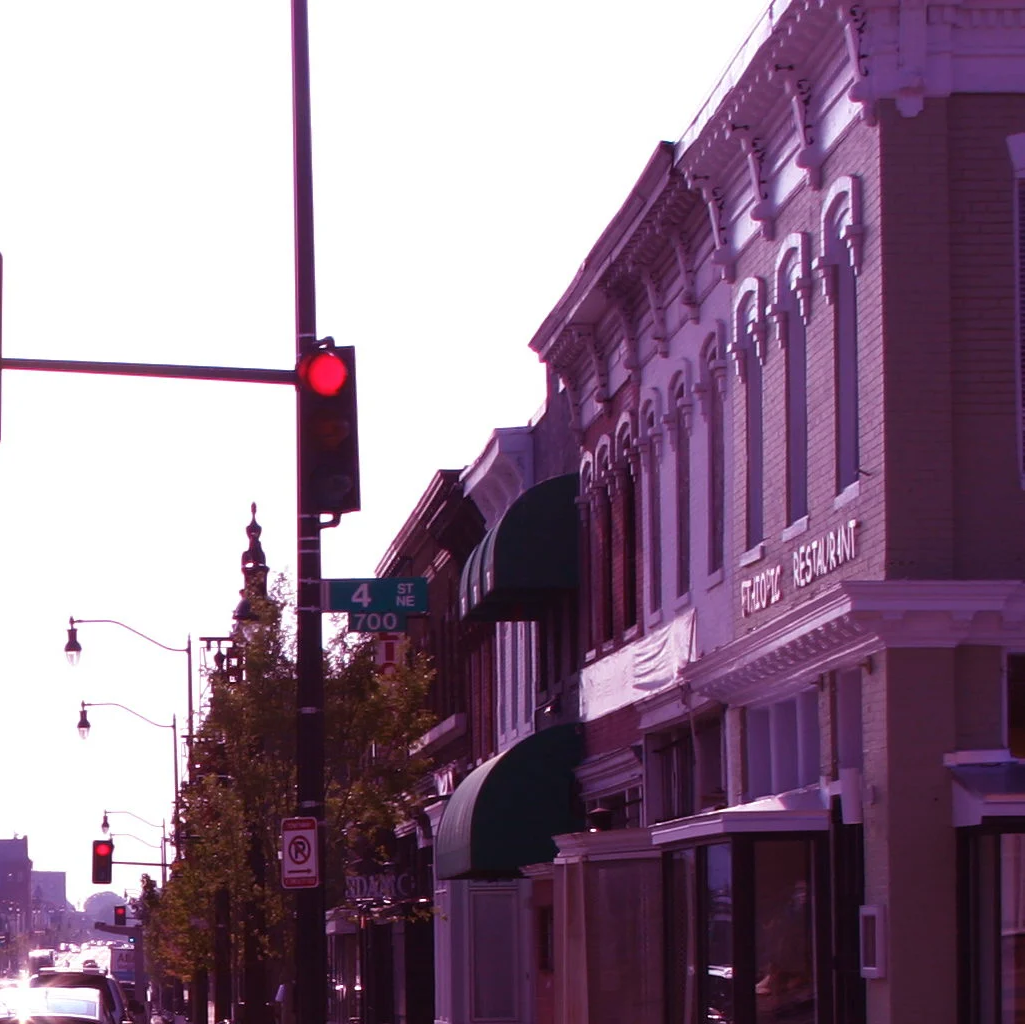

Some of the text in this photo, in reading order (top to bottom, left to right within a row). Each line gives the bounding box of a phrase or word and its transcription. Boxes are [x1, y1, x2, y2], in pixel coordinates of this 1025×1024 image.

[793, 518, 857, 588] RESTAURANT
[351, 583, 371, 607] 4
[397, 583, 414, 594] ST
[396, 595, 415, 607] NE
[354, 612, 397, 630] 700
